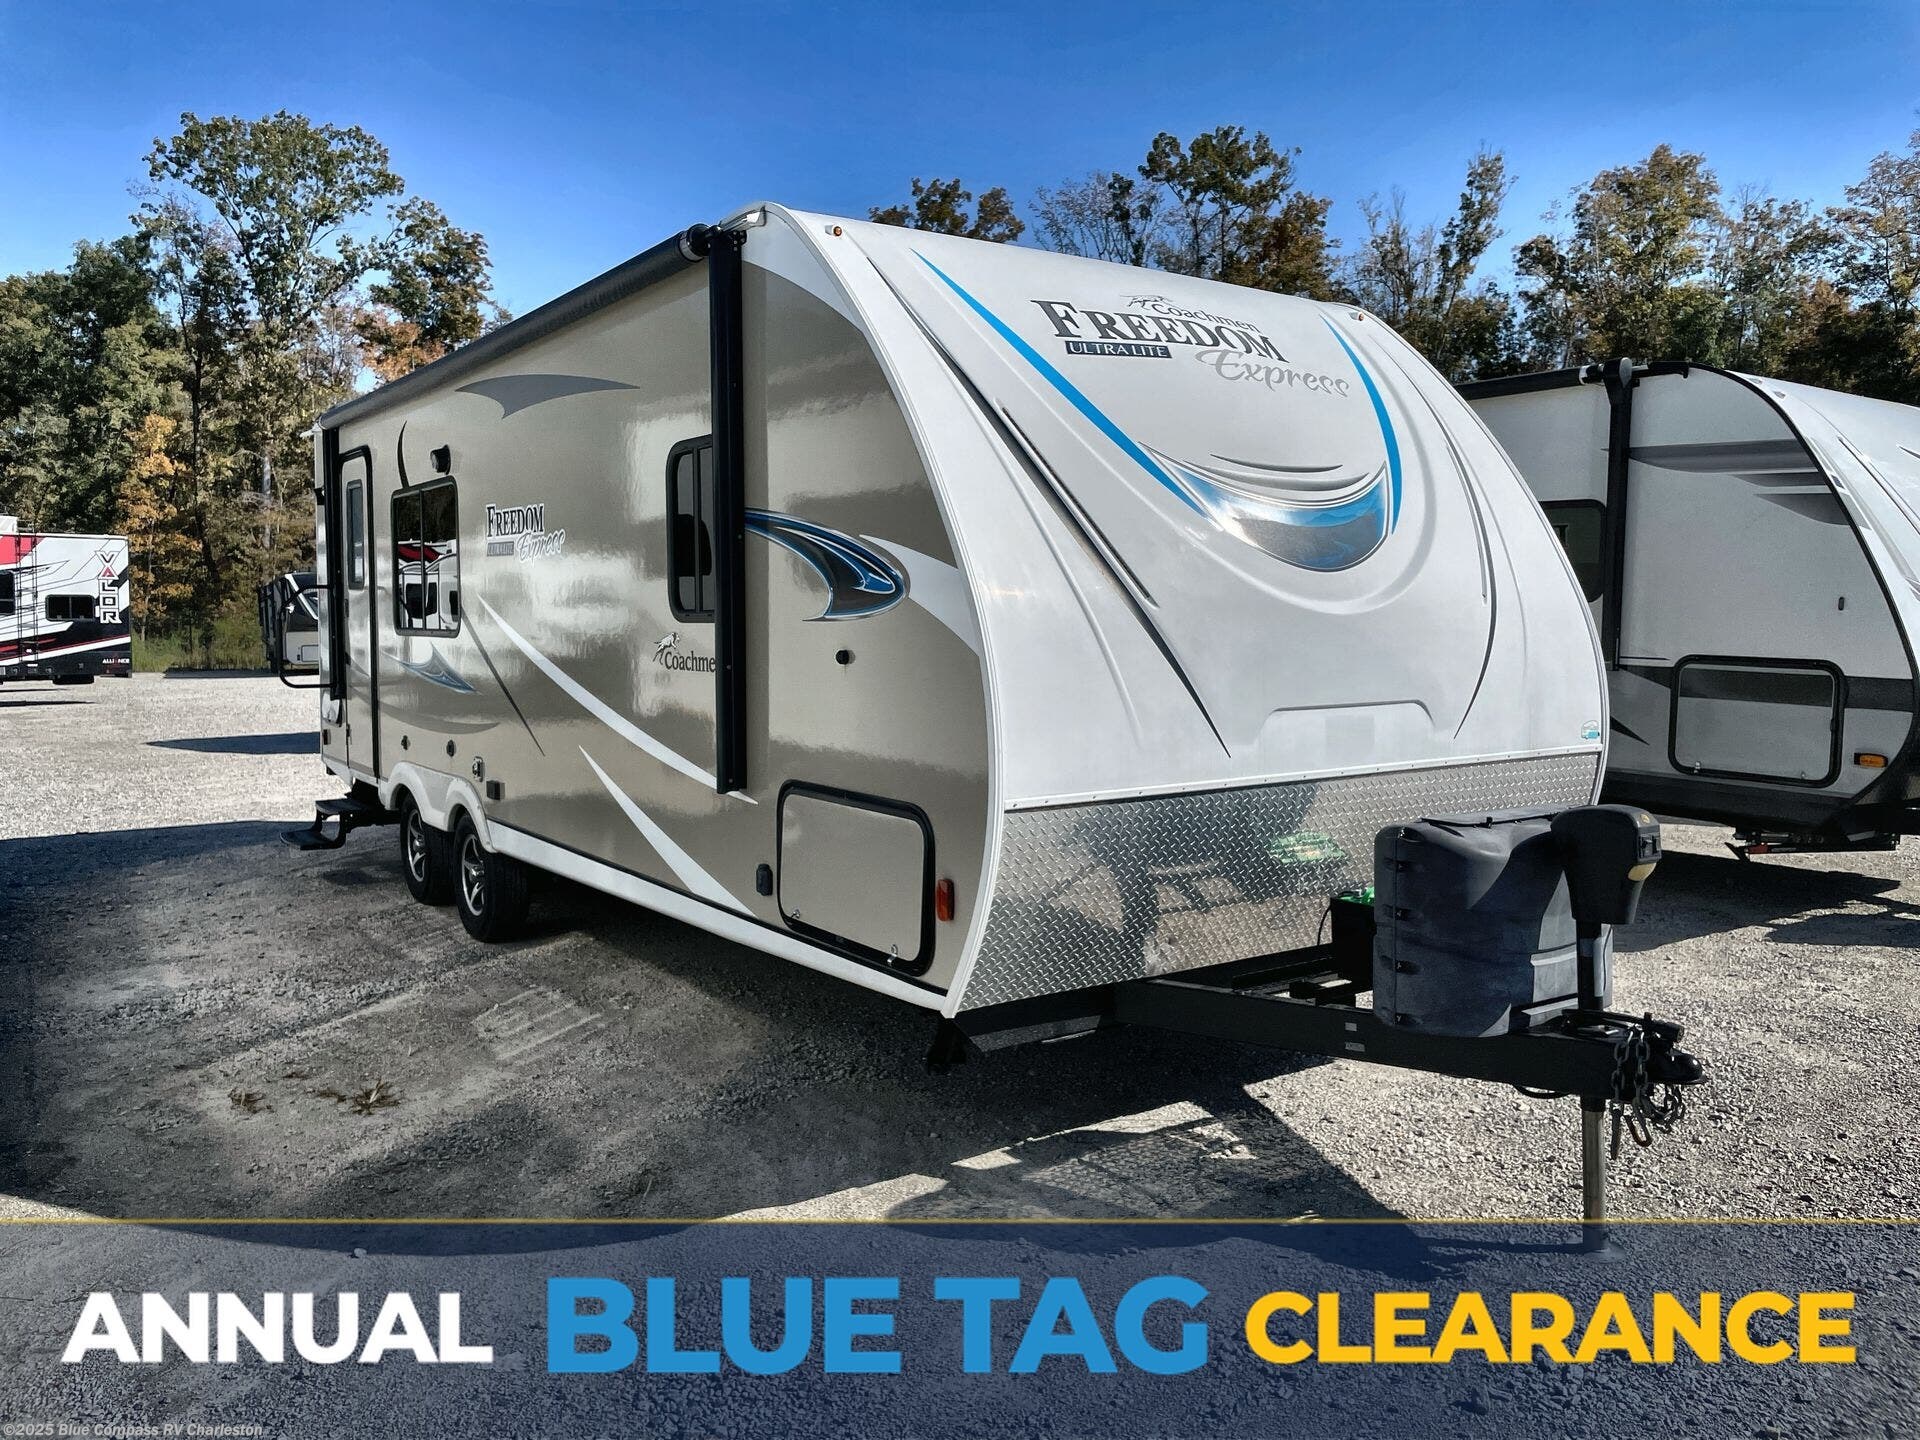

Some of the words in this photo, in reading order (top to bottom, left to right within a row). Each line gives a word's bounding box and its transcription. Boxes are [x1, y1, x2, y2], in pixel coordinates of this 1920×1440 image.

[1030, 299, 1289, 363] FREEDOM
[1151, 302, 1262, 332] Coachmen
[1068, 342, 1130, 355] ULTRA
[1135, 344, 1168, 357] LITE
[1195, 348, 1350, 397] Express
[486, 504, 544, 538] FREEDOM
[517, 529, 566, 566] Express
[95, 551, 122, 623] VALOR
[664, 650, 716, 673] Coachme
